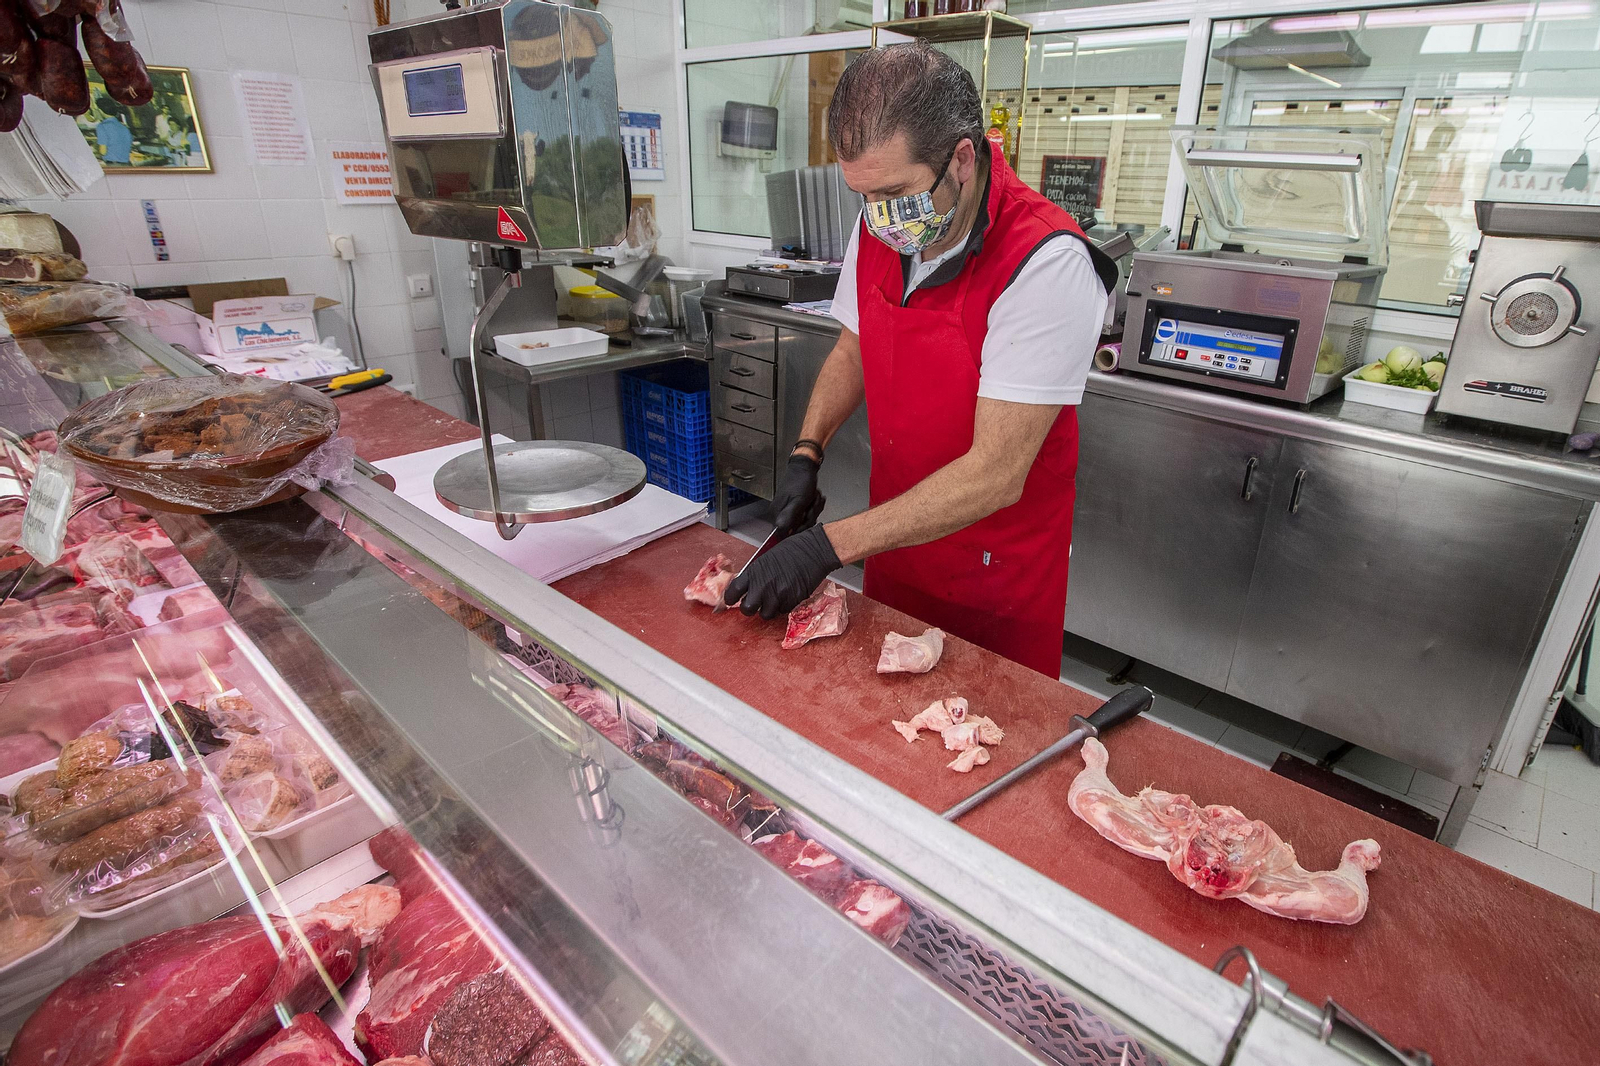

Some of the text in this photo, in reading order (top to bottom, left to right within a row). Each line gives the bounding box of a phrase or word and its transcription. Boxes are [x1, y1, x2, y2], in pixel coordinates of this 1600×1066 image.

[332, 151, 381, 160] ELABORACIÓN
[345, 177, 367, 185] VENTA
[1049, 175, 1084, 186] TENEMOS
[345, 189, 391, 197] CONSUMIDOR
[1046, 189, 1064, 200] PATA
